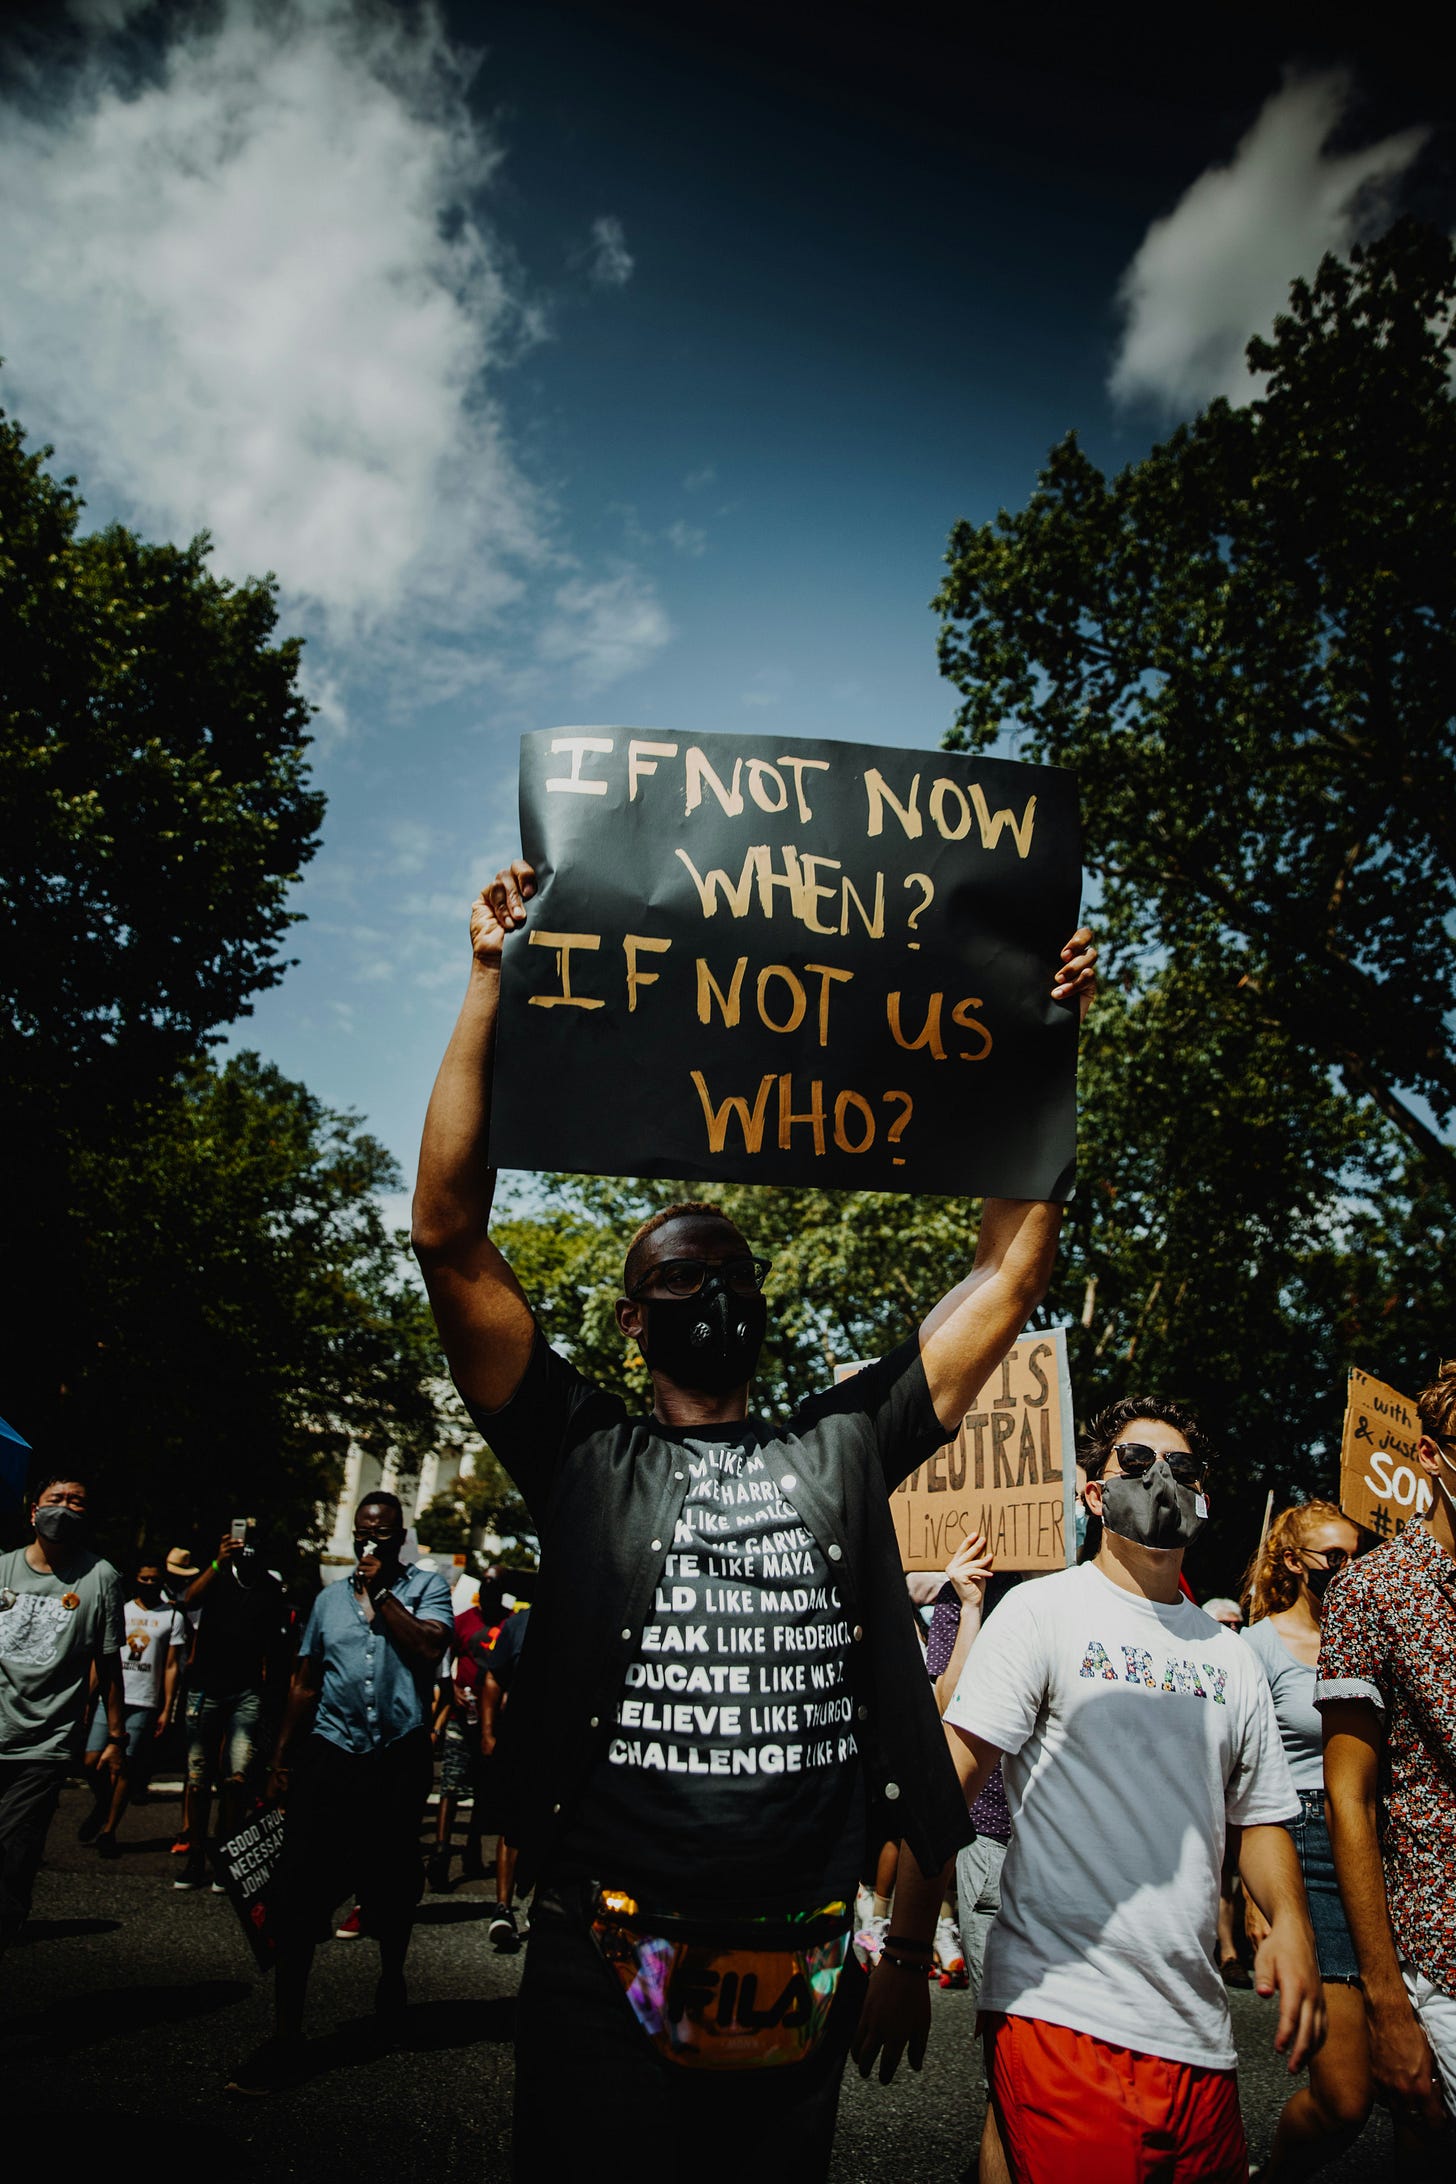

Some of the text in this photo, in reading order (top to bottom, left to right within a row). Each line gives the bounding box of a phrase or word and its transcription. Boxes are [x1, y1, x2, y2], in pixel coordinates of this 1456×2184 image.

[545, 737, 1038, 859] IF NOT NOW
[528, 930, 993, 1062] IF NOT US
[689, 1070, 914, 1166] WHO?
[992, 1343, 1053, 1410] IS
[896, 1406, 1064, 1494] EUTRAL
[1354, 1415, 1421, 1463] & just
[709, 1449, 744, 1478] LIKE
[685, 1478, 720, 1501] IKE
[686, 1508, 731, 1532] LIKE
[973, 1499, 1067, 1559] MATTER
[708, 1556, 755, 1578] LIKE
[762, 1551, 815, 1578] MAYA
[653, 1585, 698, 1613] LD
[705, 1587, 754, 1614] LIKE
[760, 1587, 829, 1614] MADAM
[640, 1624, 710, 1653] EAK
[717, 1626, 766, 1653] LIKE
[759, 1665, 807, 1694] LIKE
[1079, 1640, 1228, 1705] ARMY
[616, 1695, 854, 1736] ELIEVE LIKE THURGO
[608, 1736, 804, 1776] CHALLENGE
[805, 1739, 834, 1769] LIKE
[241, 1864, 271, 1899] JOHN
[667, 1967, 811, 2028] FILA
